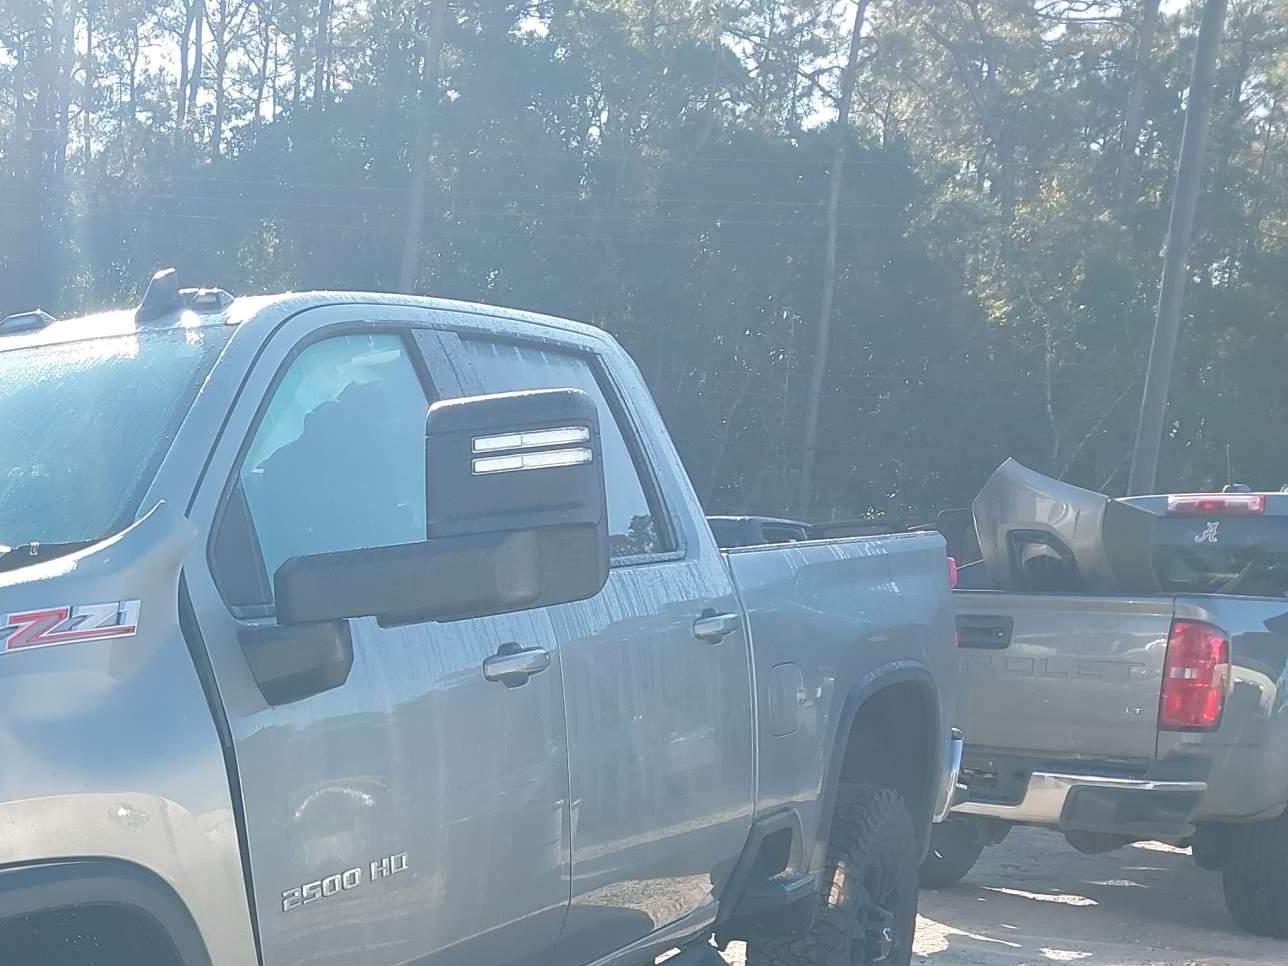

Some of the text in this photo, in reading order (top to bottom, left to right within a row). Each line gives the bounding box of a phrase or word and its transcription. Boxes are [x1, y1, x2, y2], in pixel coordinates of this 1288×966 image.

[961, 655, 1145, 682] ROLET
[281, 851, 409, 912] 2500 HD
